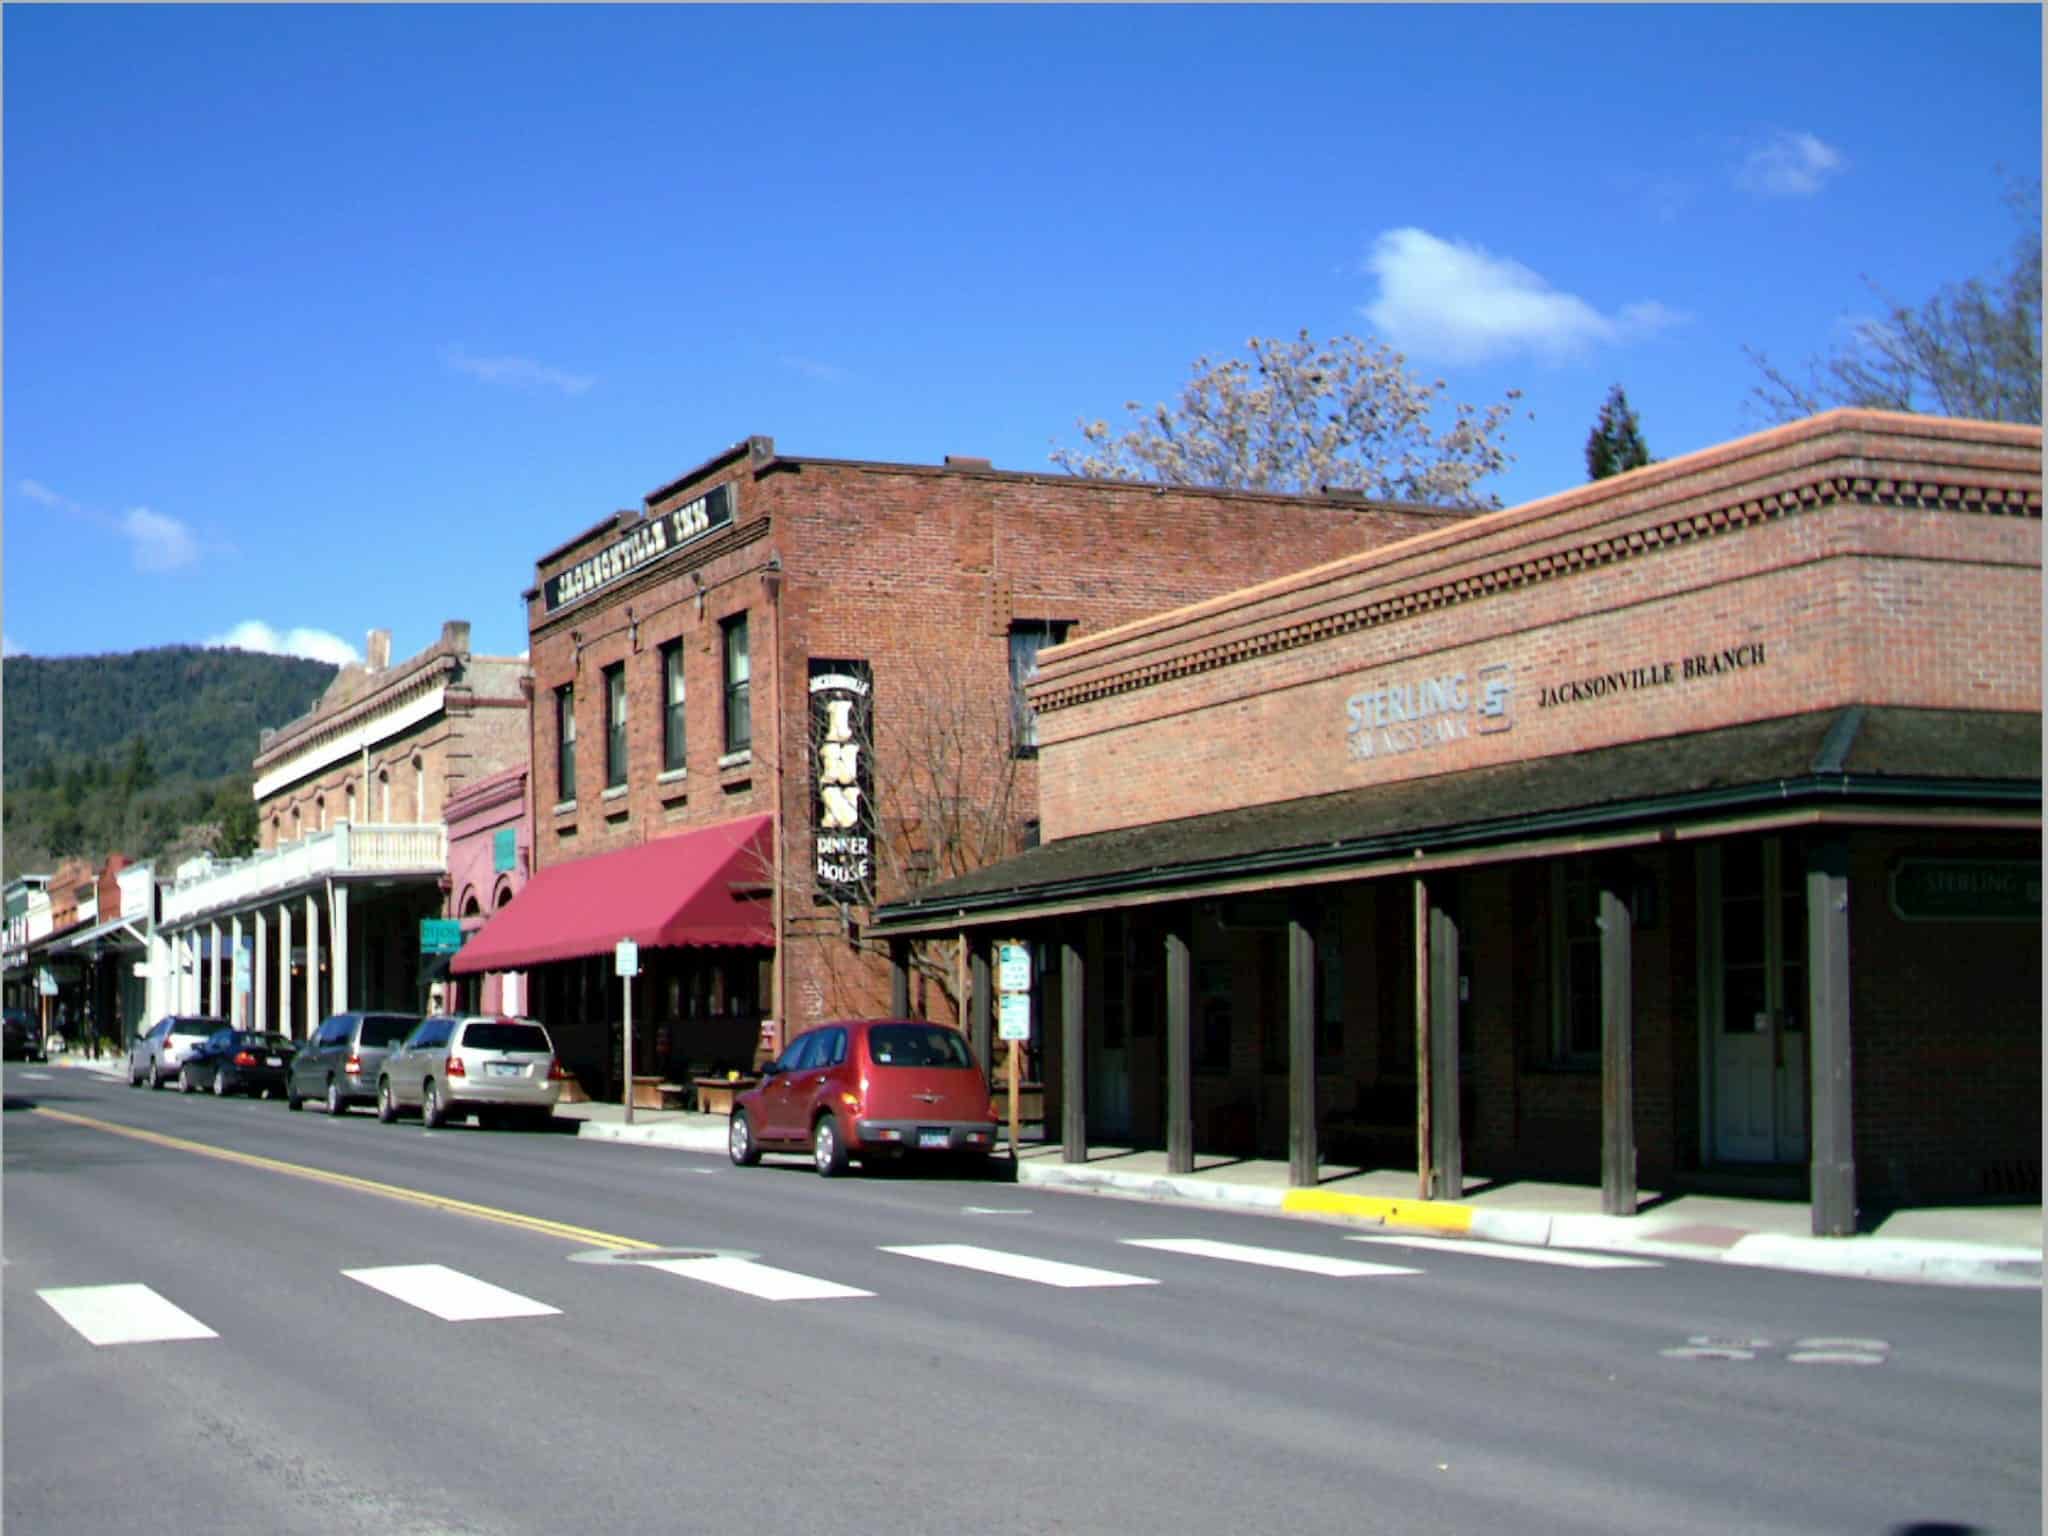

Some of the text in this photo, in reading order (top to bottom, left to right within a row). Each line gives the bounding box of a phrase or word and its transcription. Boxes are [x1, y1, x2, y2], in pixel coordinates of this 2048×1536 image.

[557, 496, 710, 604] JACKSONVILLE INN
[1345, 671, 1470, 735] STERLING
[1538, 642, 1766, 708] JACKSONVILLE BRANCH
[816, 836, 869, 855] DINNER
[817, 857, 869, 883] HOUSE
